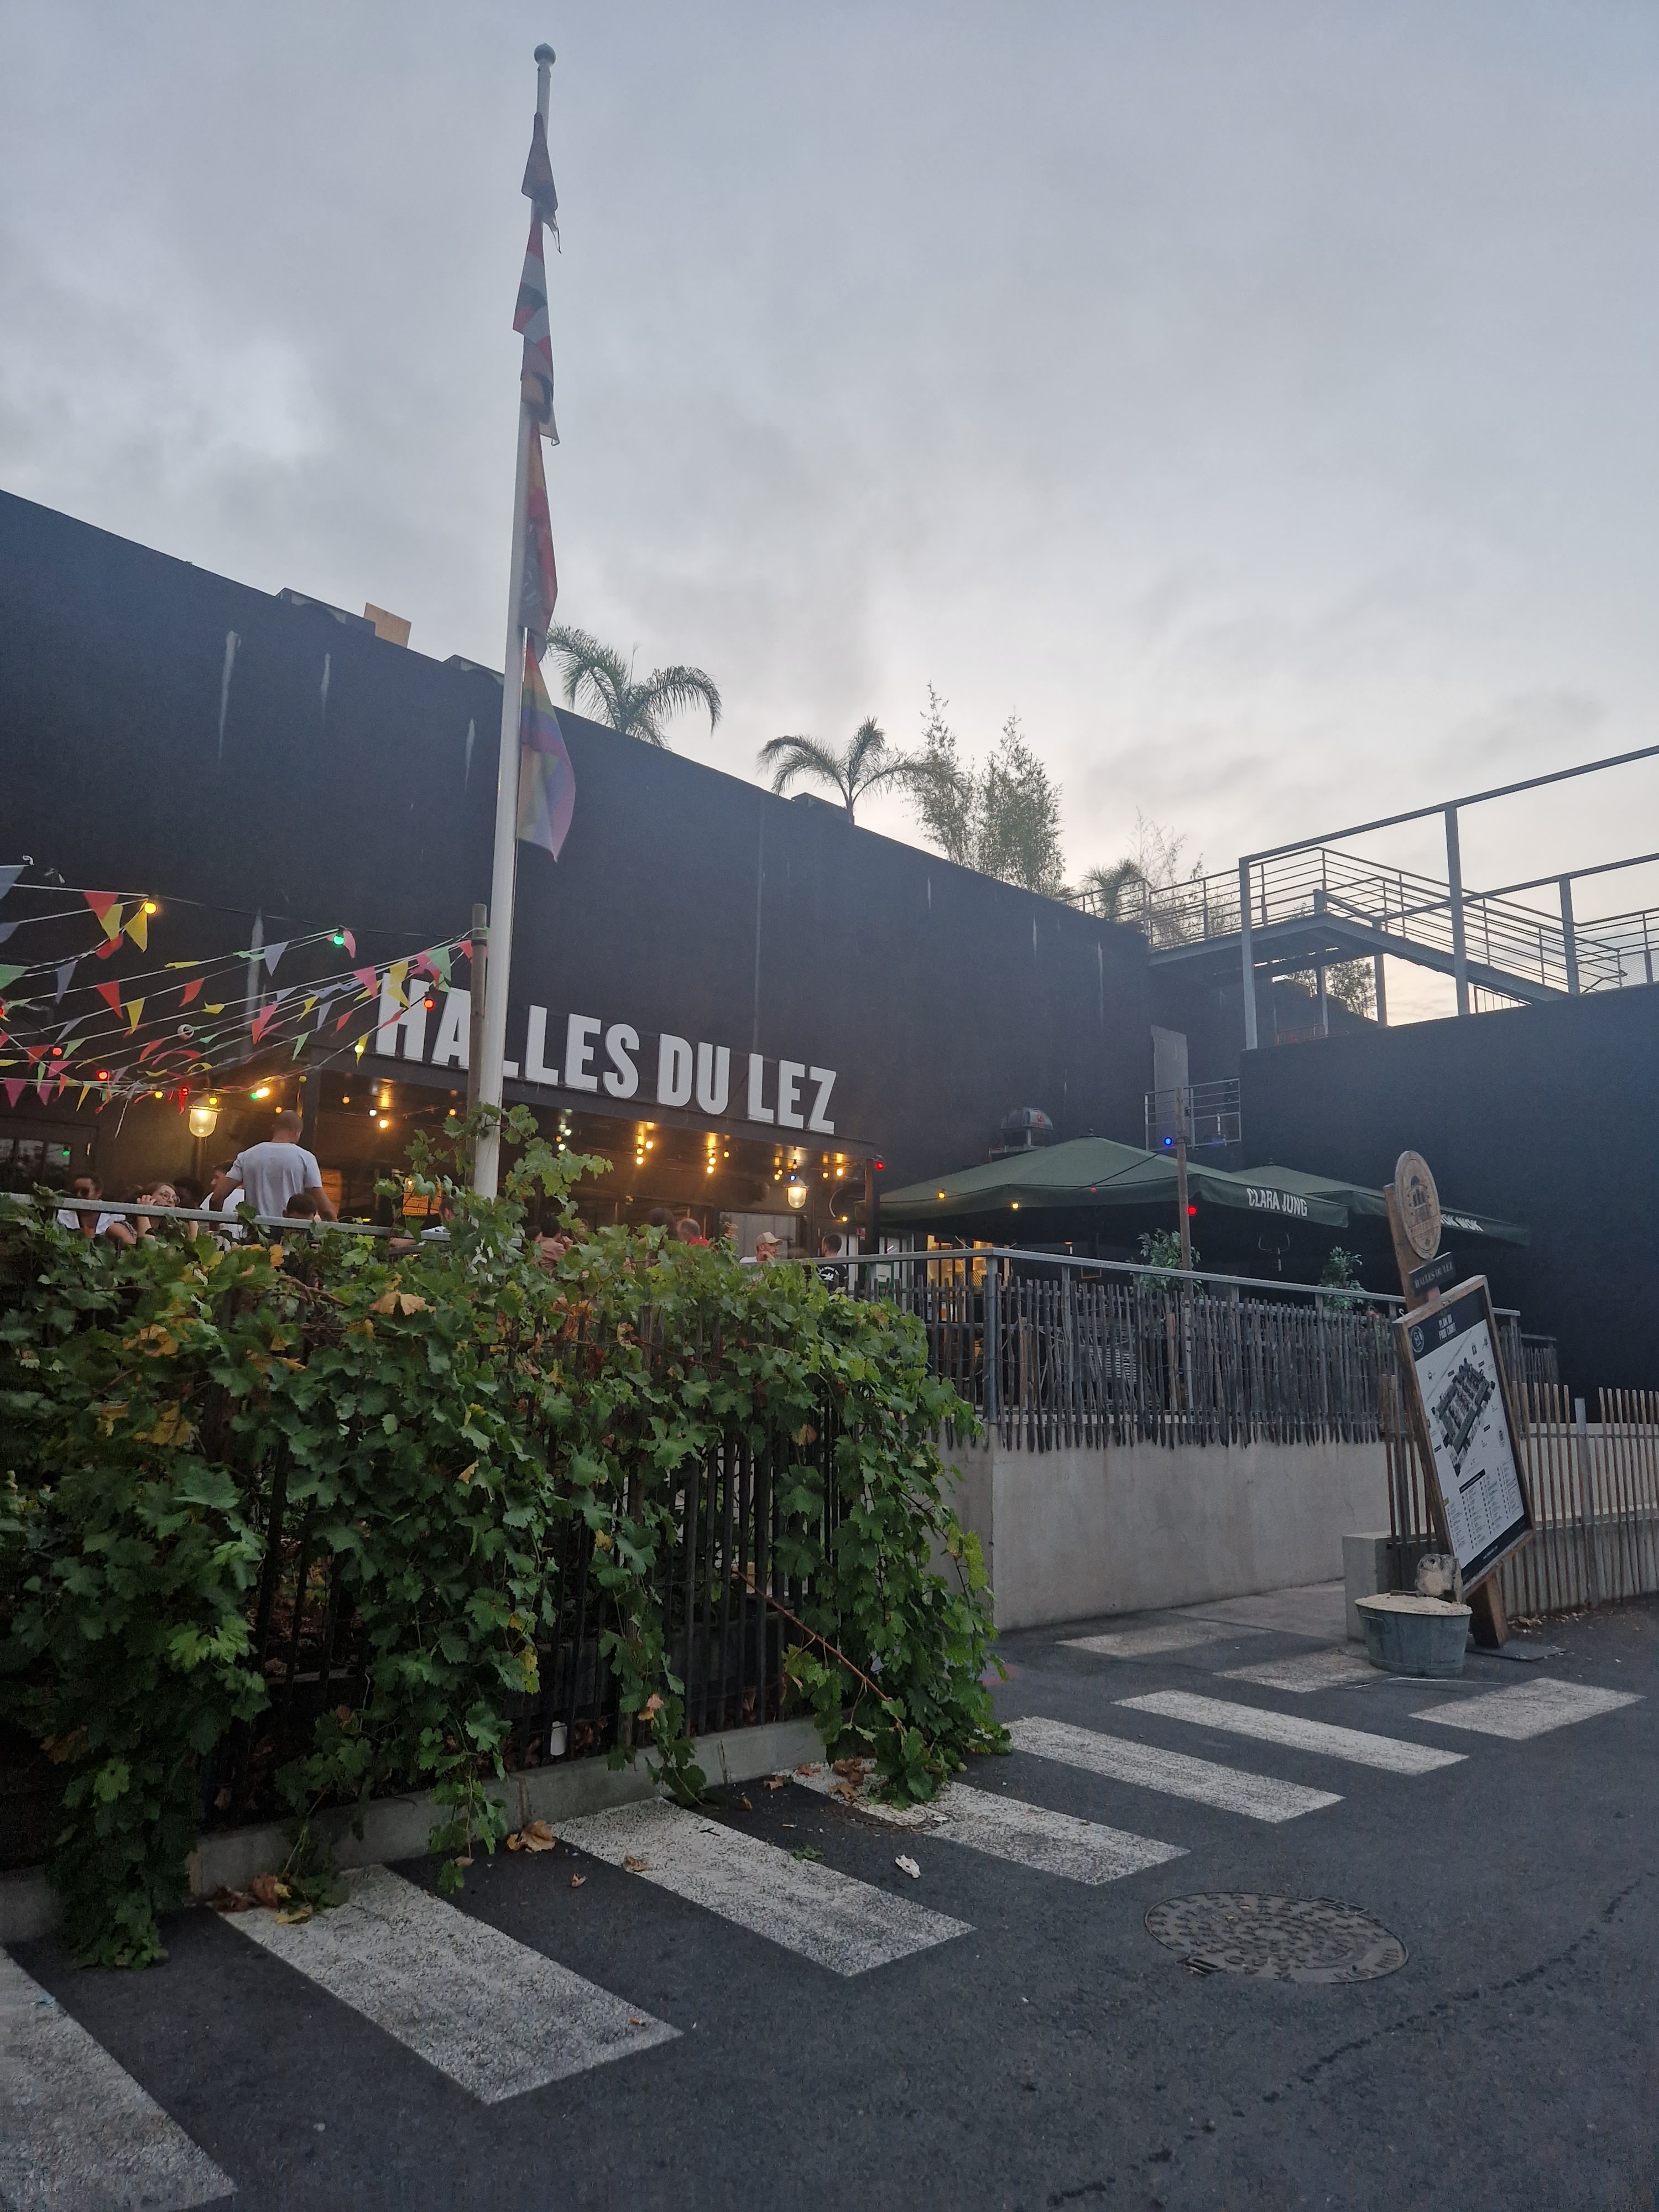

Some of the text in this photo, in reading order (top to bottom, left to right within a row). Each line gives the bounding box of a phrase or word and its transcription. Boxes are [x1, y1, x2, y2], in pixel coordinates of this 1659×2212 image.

[376, 972, 837, 1134] HALES DU LEZ
[1246, 1187, 1308, 1217] CLARA JUNG
[1440, 1213, 1460, 1227] OK
